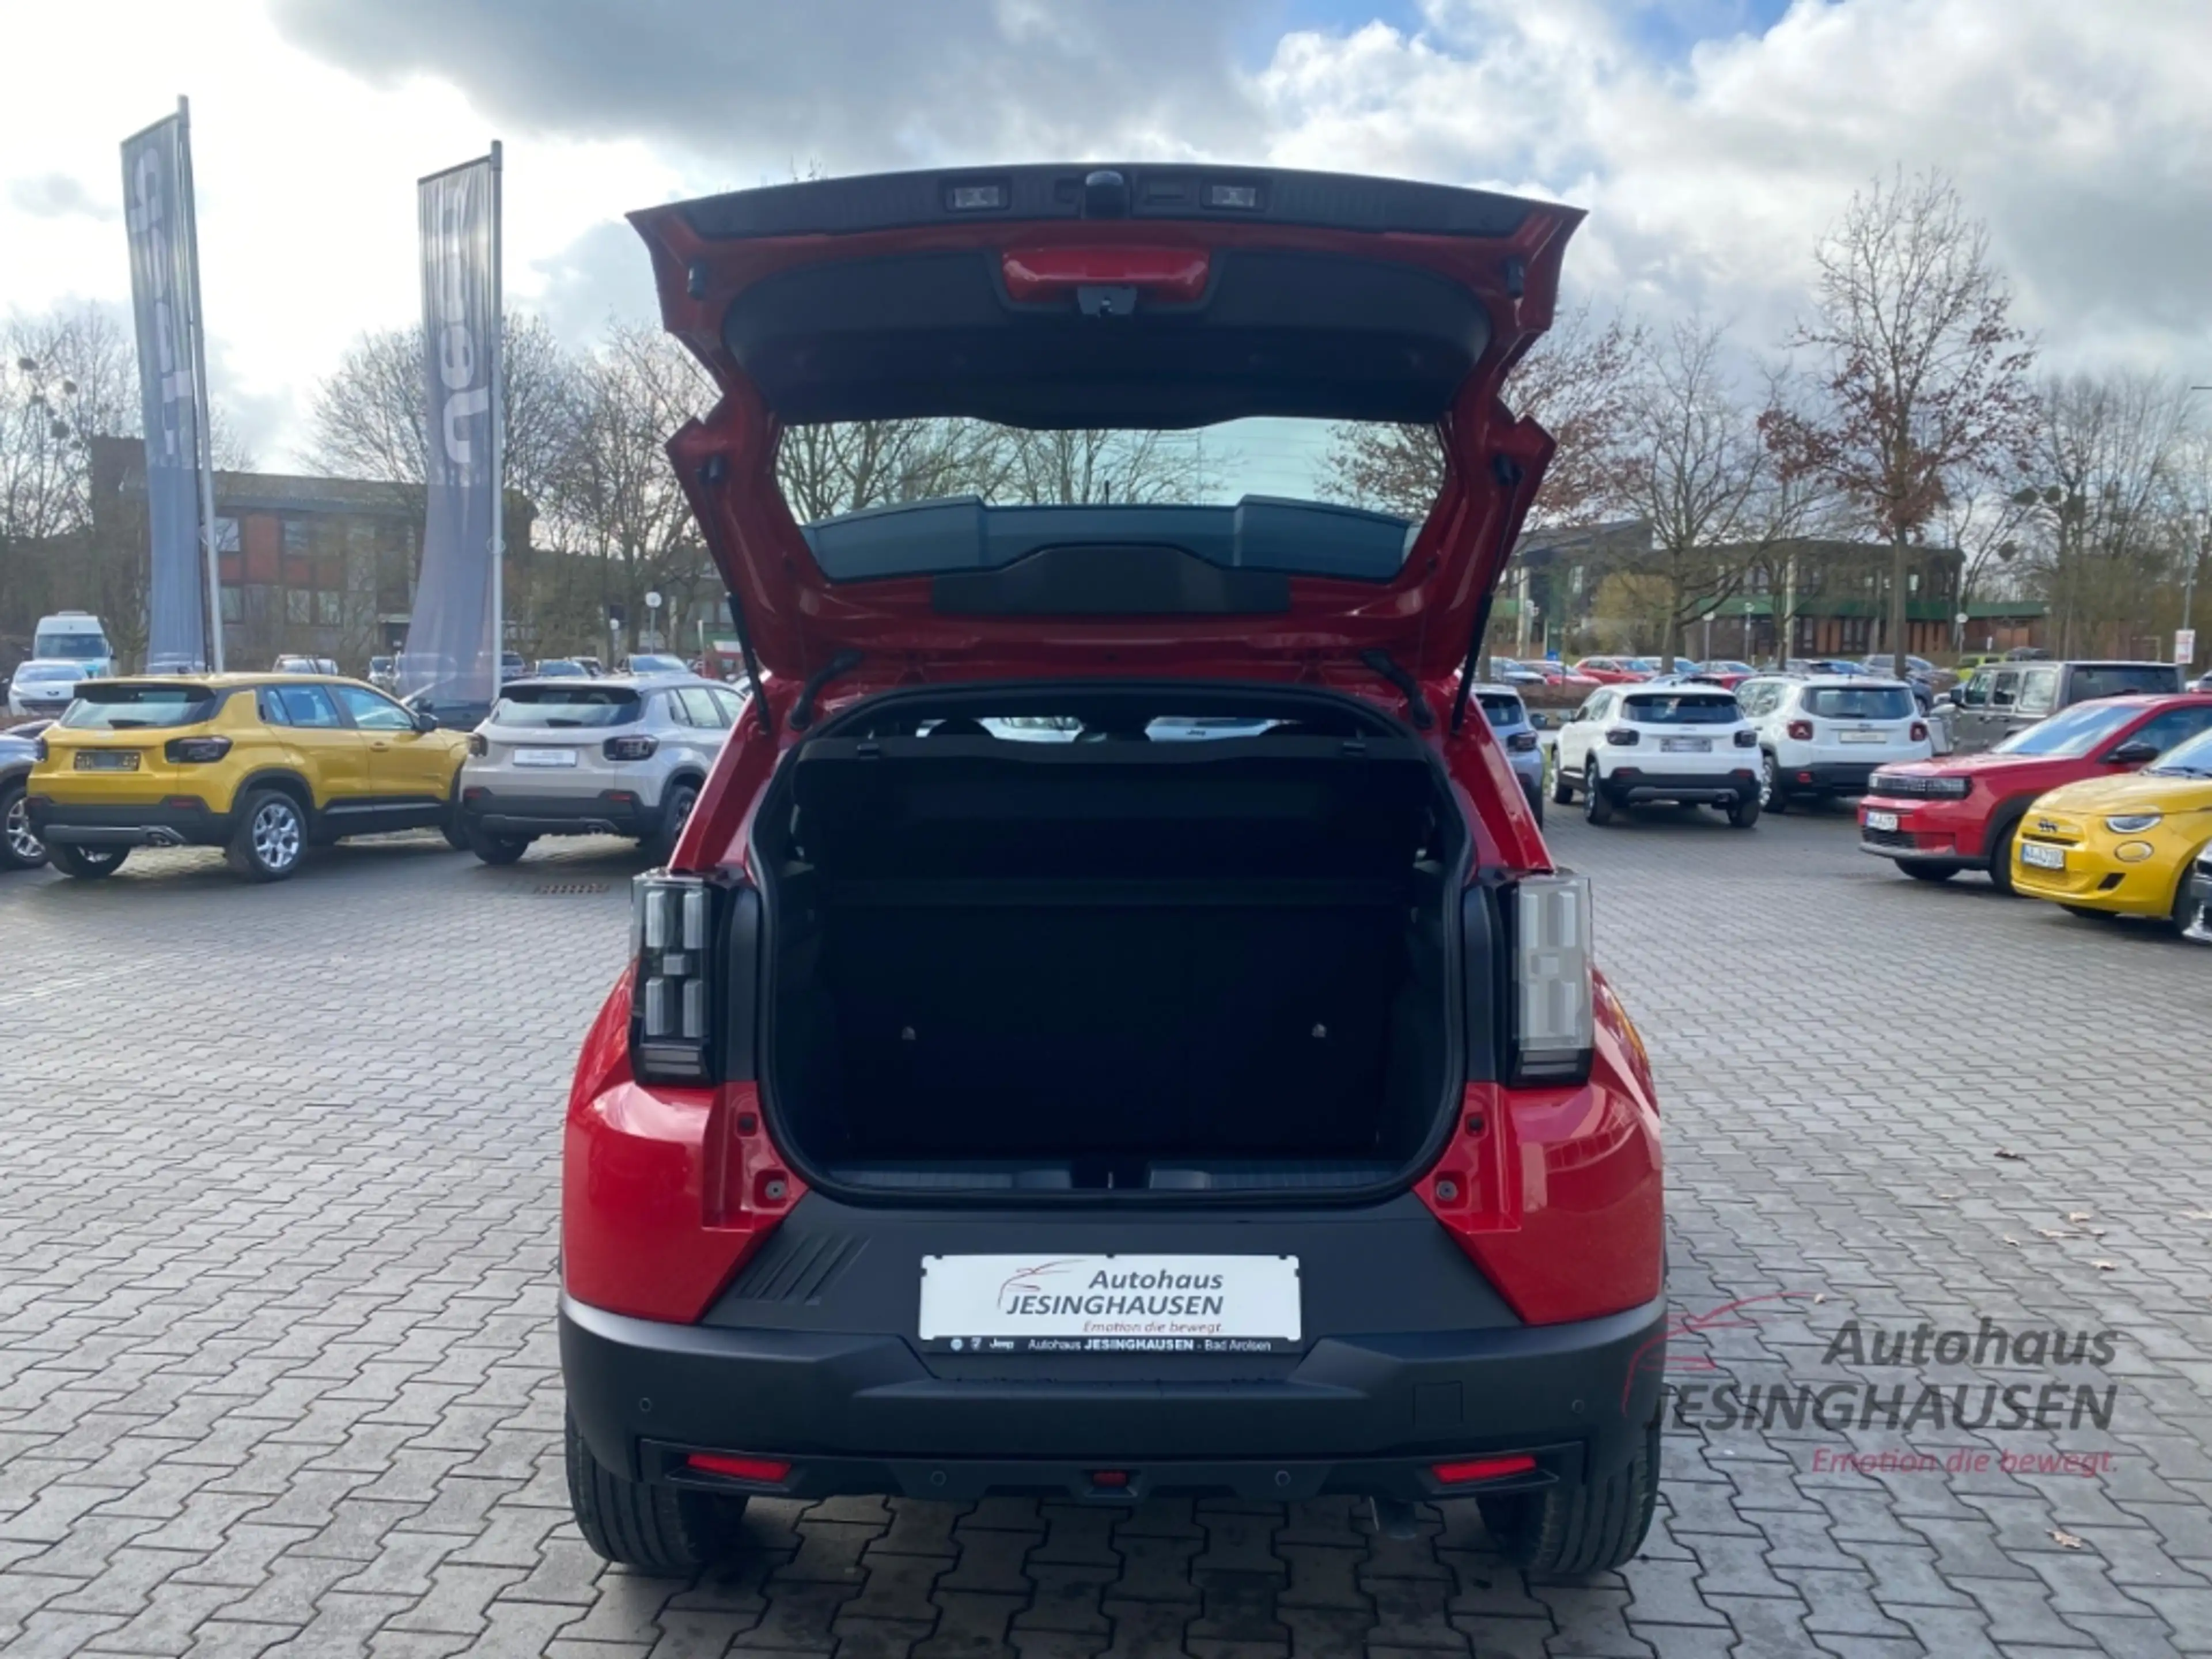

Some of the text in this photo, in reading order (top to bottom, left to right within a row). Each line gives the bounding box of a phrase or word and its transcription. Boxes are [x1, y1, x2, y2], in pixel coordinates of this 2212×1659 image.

[1088, 1268, 1224, 1290] Autohaus
[1006, 1295, 1224, 1315] JESINGHAUSEN
[1082, 1320, 1142, 1333] Emotion
[1144, 1320, 1165, 1333] die
[1028, 1338, 1081, 1351] Autohaus
[1084, 1338, 1194, 1351] JESINGHAUSEN
[1204, 1338, 1227, 1351] Bad
[1229, 1339, 1272, 1351] Arolsen
